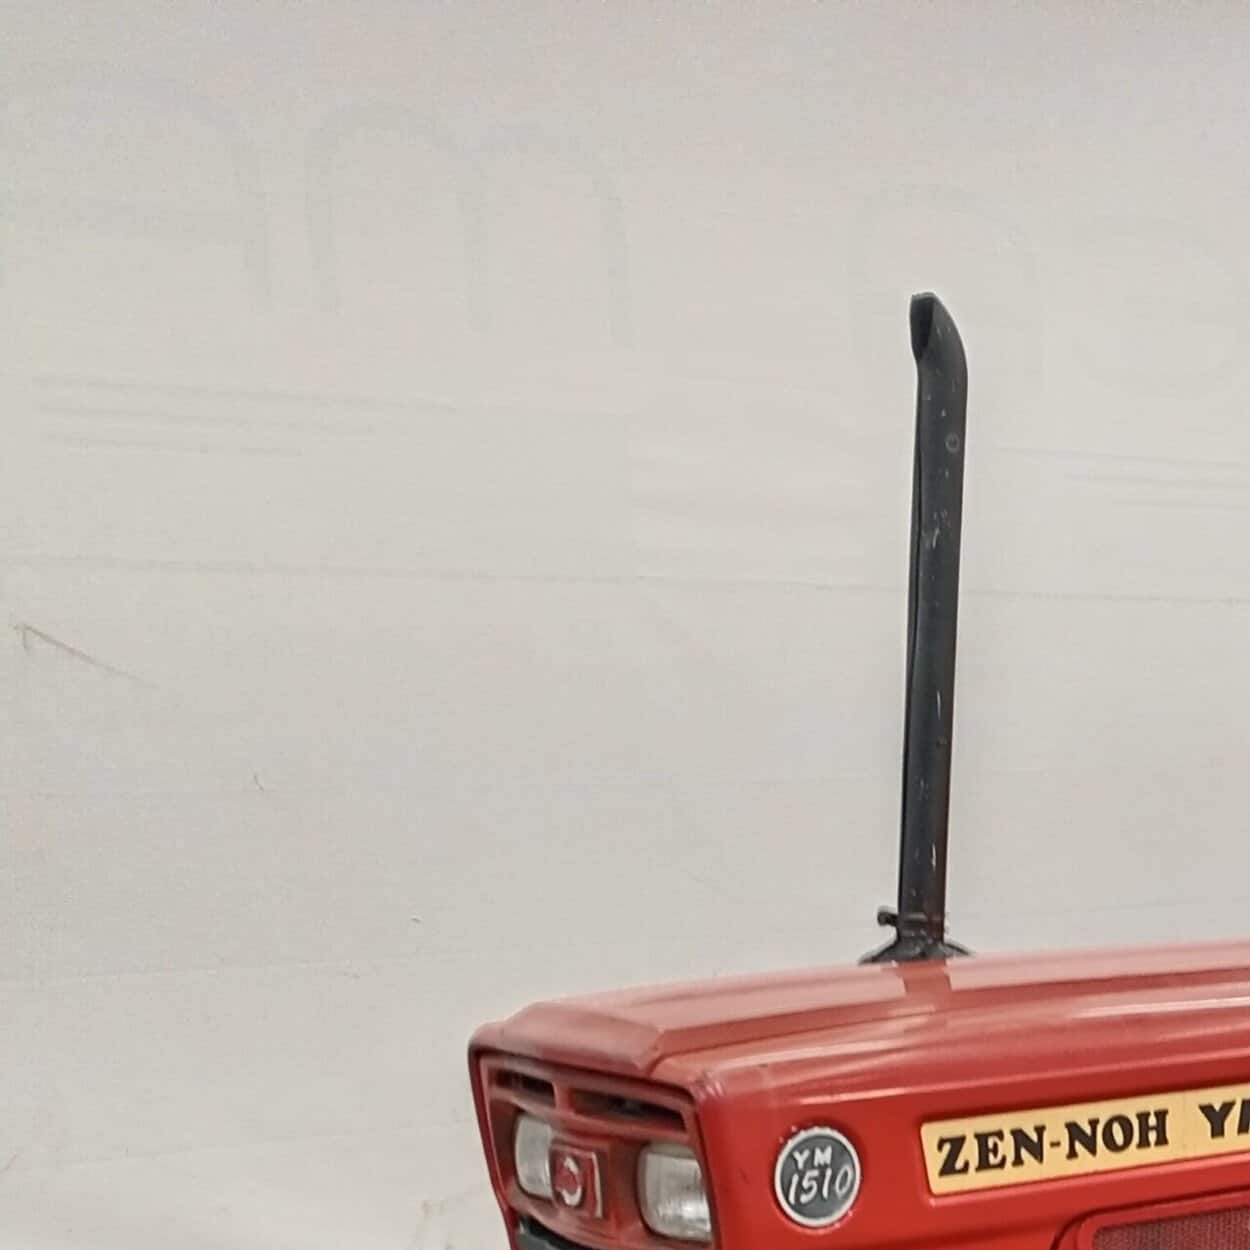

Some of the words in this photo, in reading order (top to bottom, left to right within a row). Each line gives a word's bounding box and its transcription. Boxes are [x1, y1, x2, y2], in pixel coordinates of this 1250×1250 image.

[793, 1145, 832, 1169] YM
[937, 1109, 1168, 1178] ZEN-NOH
[788, 1165, 853, 1205] 1510
